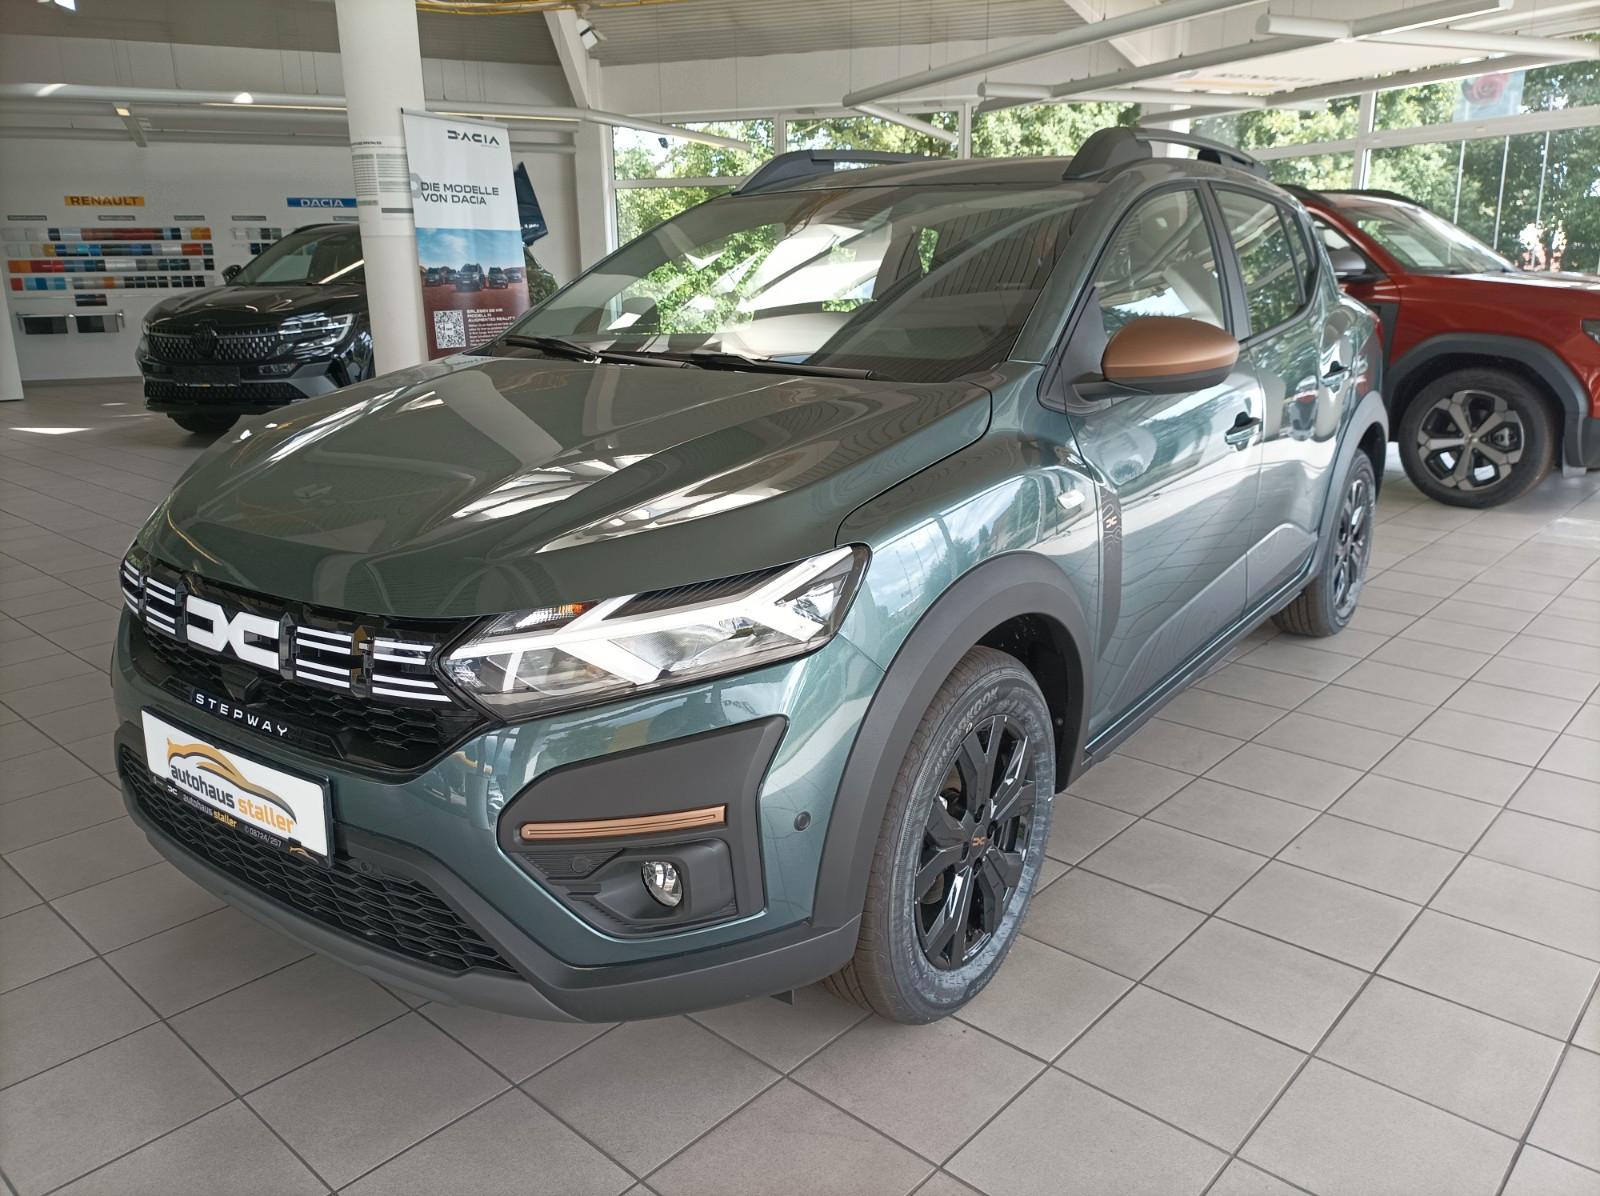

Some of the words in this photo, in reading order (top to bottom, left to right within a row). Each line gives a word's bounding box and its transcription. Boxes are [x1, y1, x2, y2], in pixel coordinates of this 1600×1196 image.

[447, 130, 500, 145] DACIA
[421, 181, 441, 192] DIE
[443, 183, 500, 195] MODELLE
[69, 196, 139, 206] RENAULT
[299, 198, 344, 208] DACIA
[422, 194, 448, 203] VON
[451, 194, 487, 205] DACIA
[195, 693, 288, 737] STEPWAY
[171, 764, 235, 809] autohaus
[238, 797, 295, 833] staller
[182, 793, 213, 816] autohaus
[213, 809, 238, 829] staller
